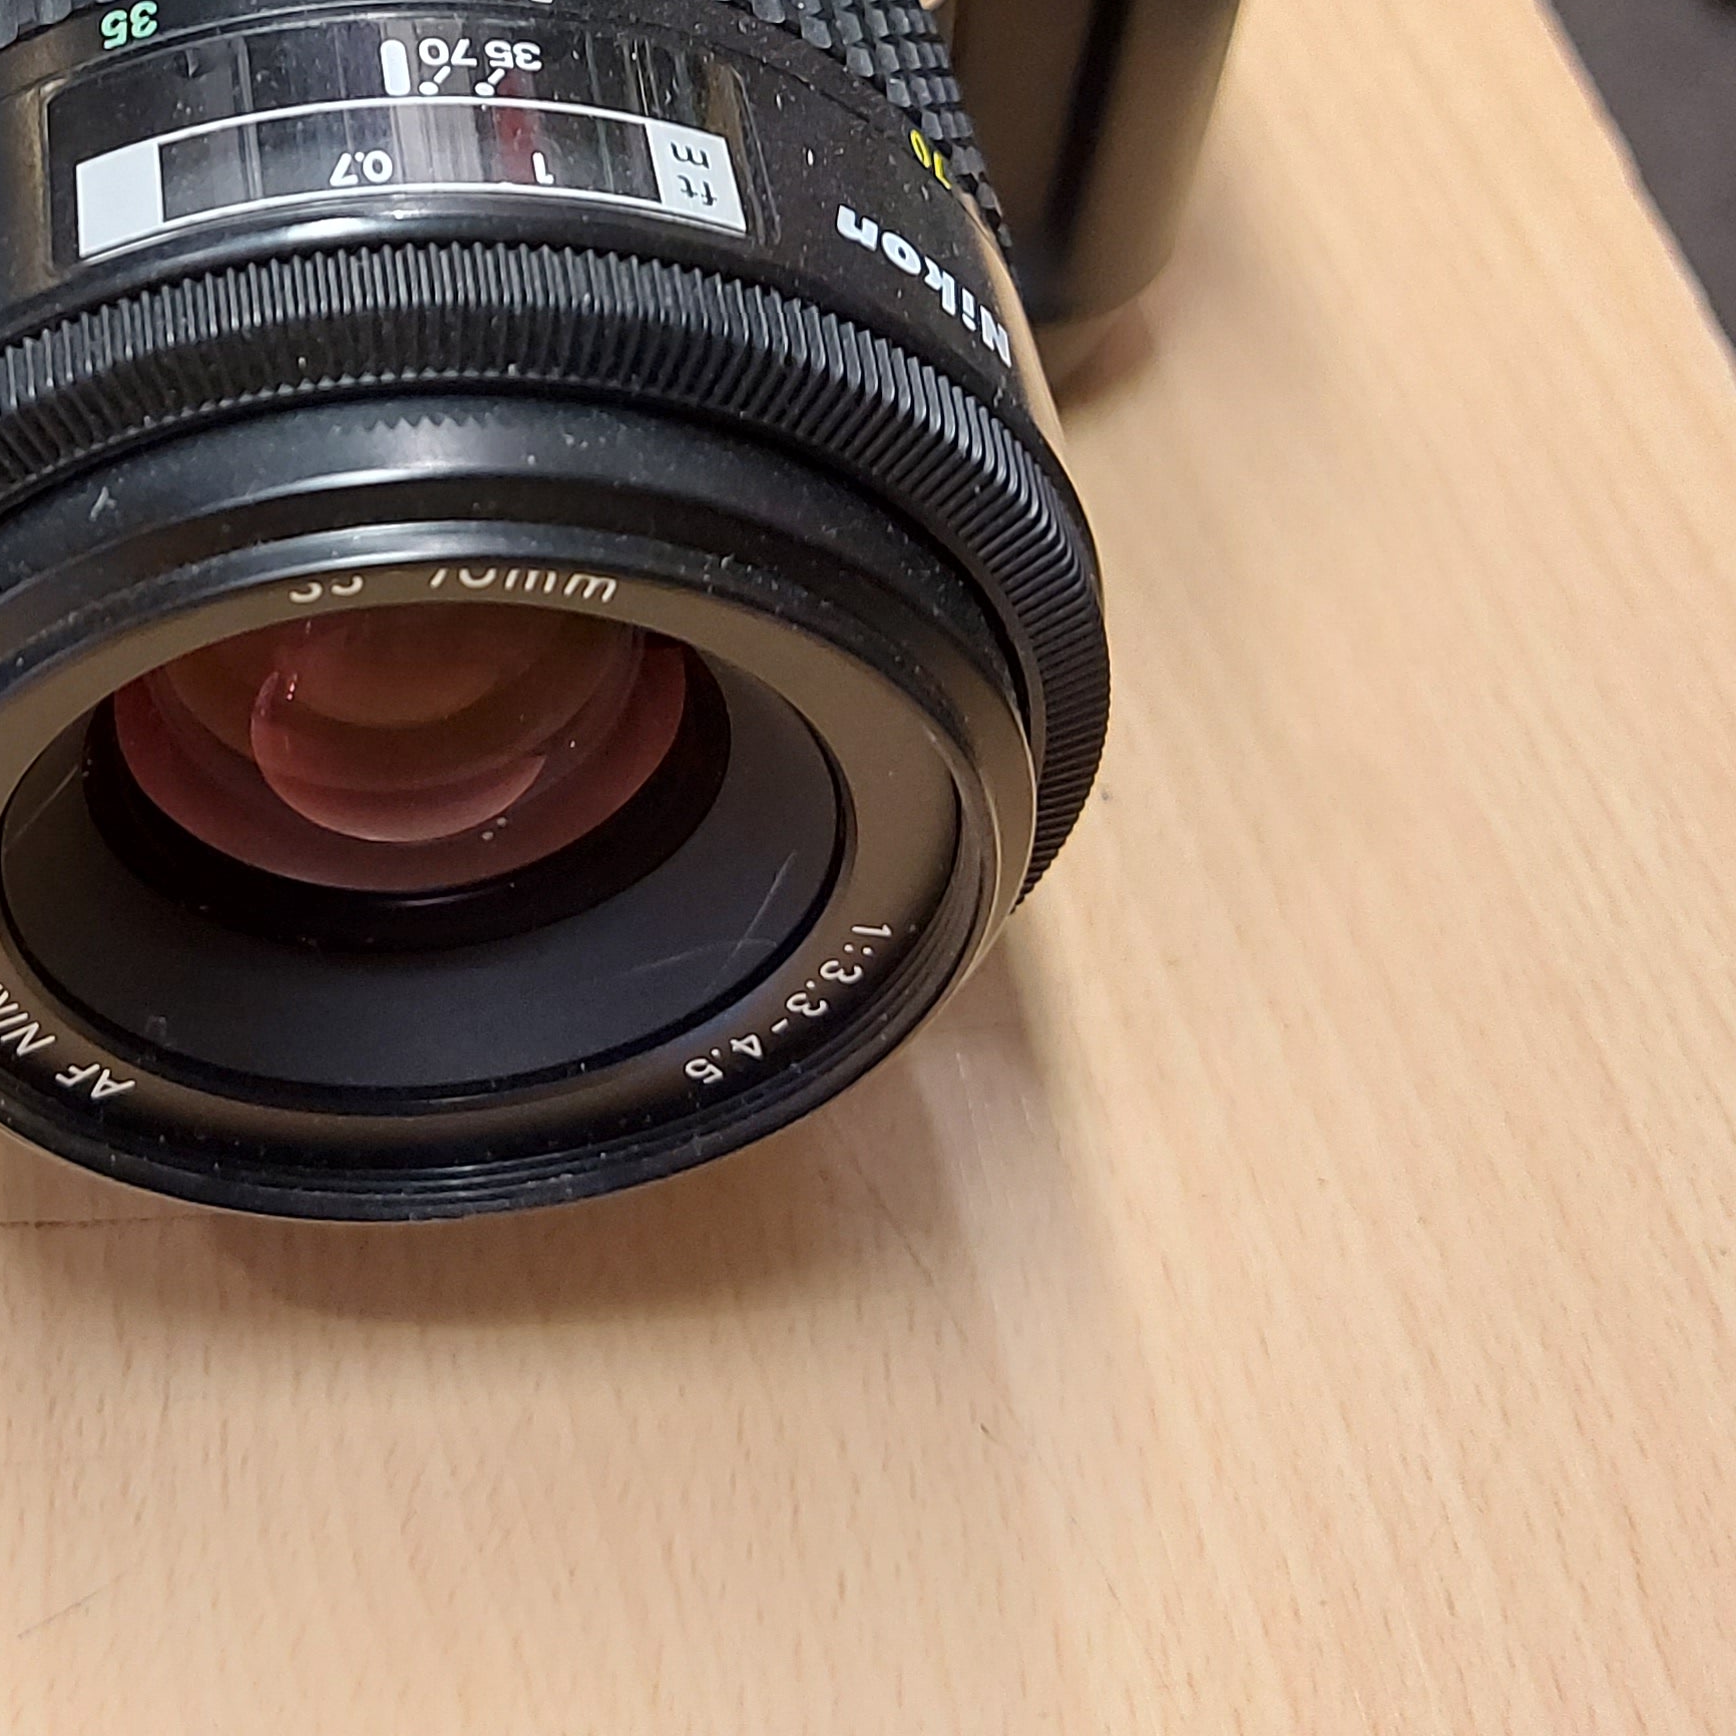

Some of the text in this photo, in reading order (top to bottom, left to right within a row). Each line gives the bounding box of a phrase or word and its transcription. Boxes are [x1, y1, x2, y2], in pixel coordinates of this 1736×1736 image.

[100, 0, 159, 51] 35
[418, 37, 543, 70] 70 35
[329, 150, 394, 187] 0.7
[532, 151, 555, 185] 1
[670, 141, 711, 170] m
[836, 202, 1012, 369] Nikon
[684, 922, 894, 1085] 1:3.3-4.5
[54, 1062, 137, 1100] AF
